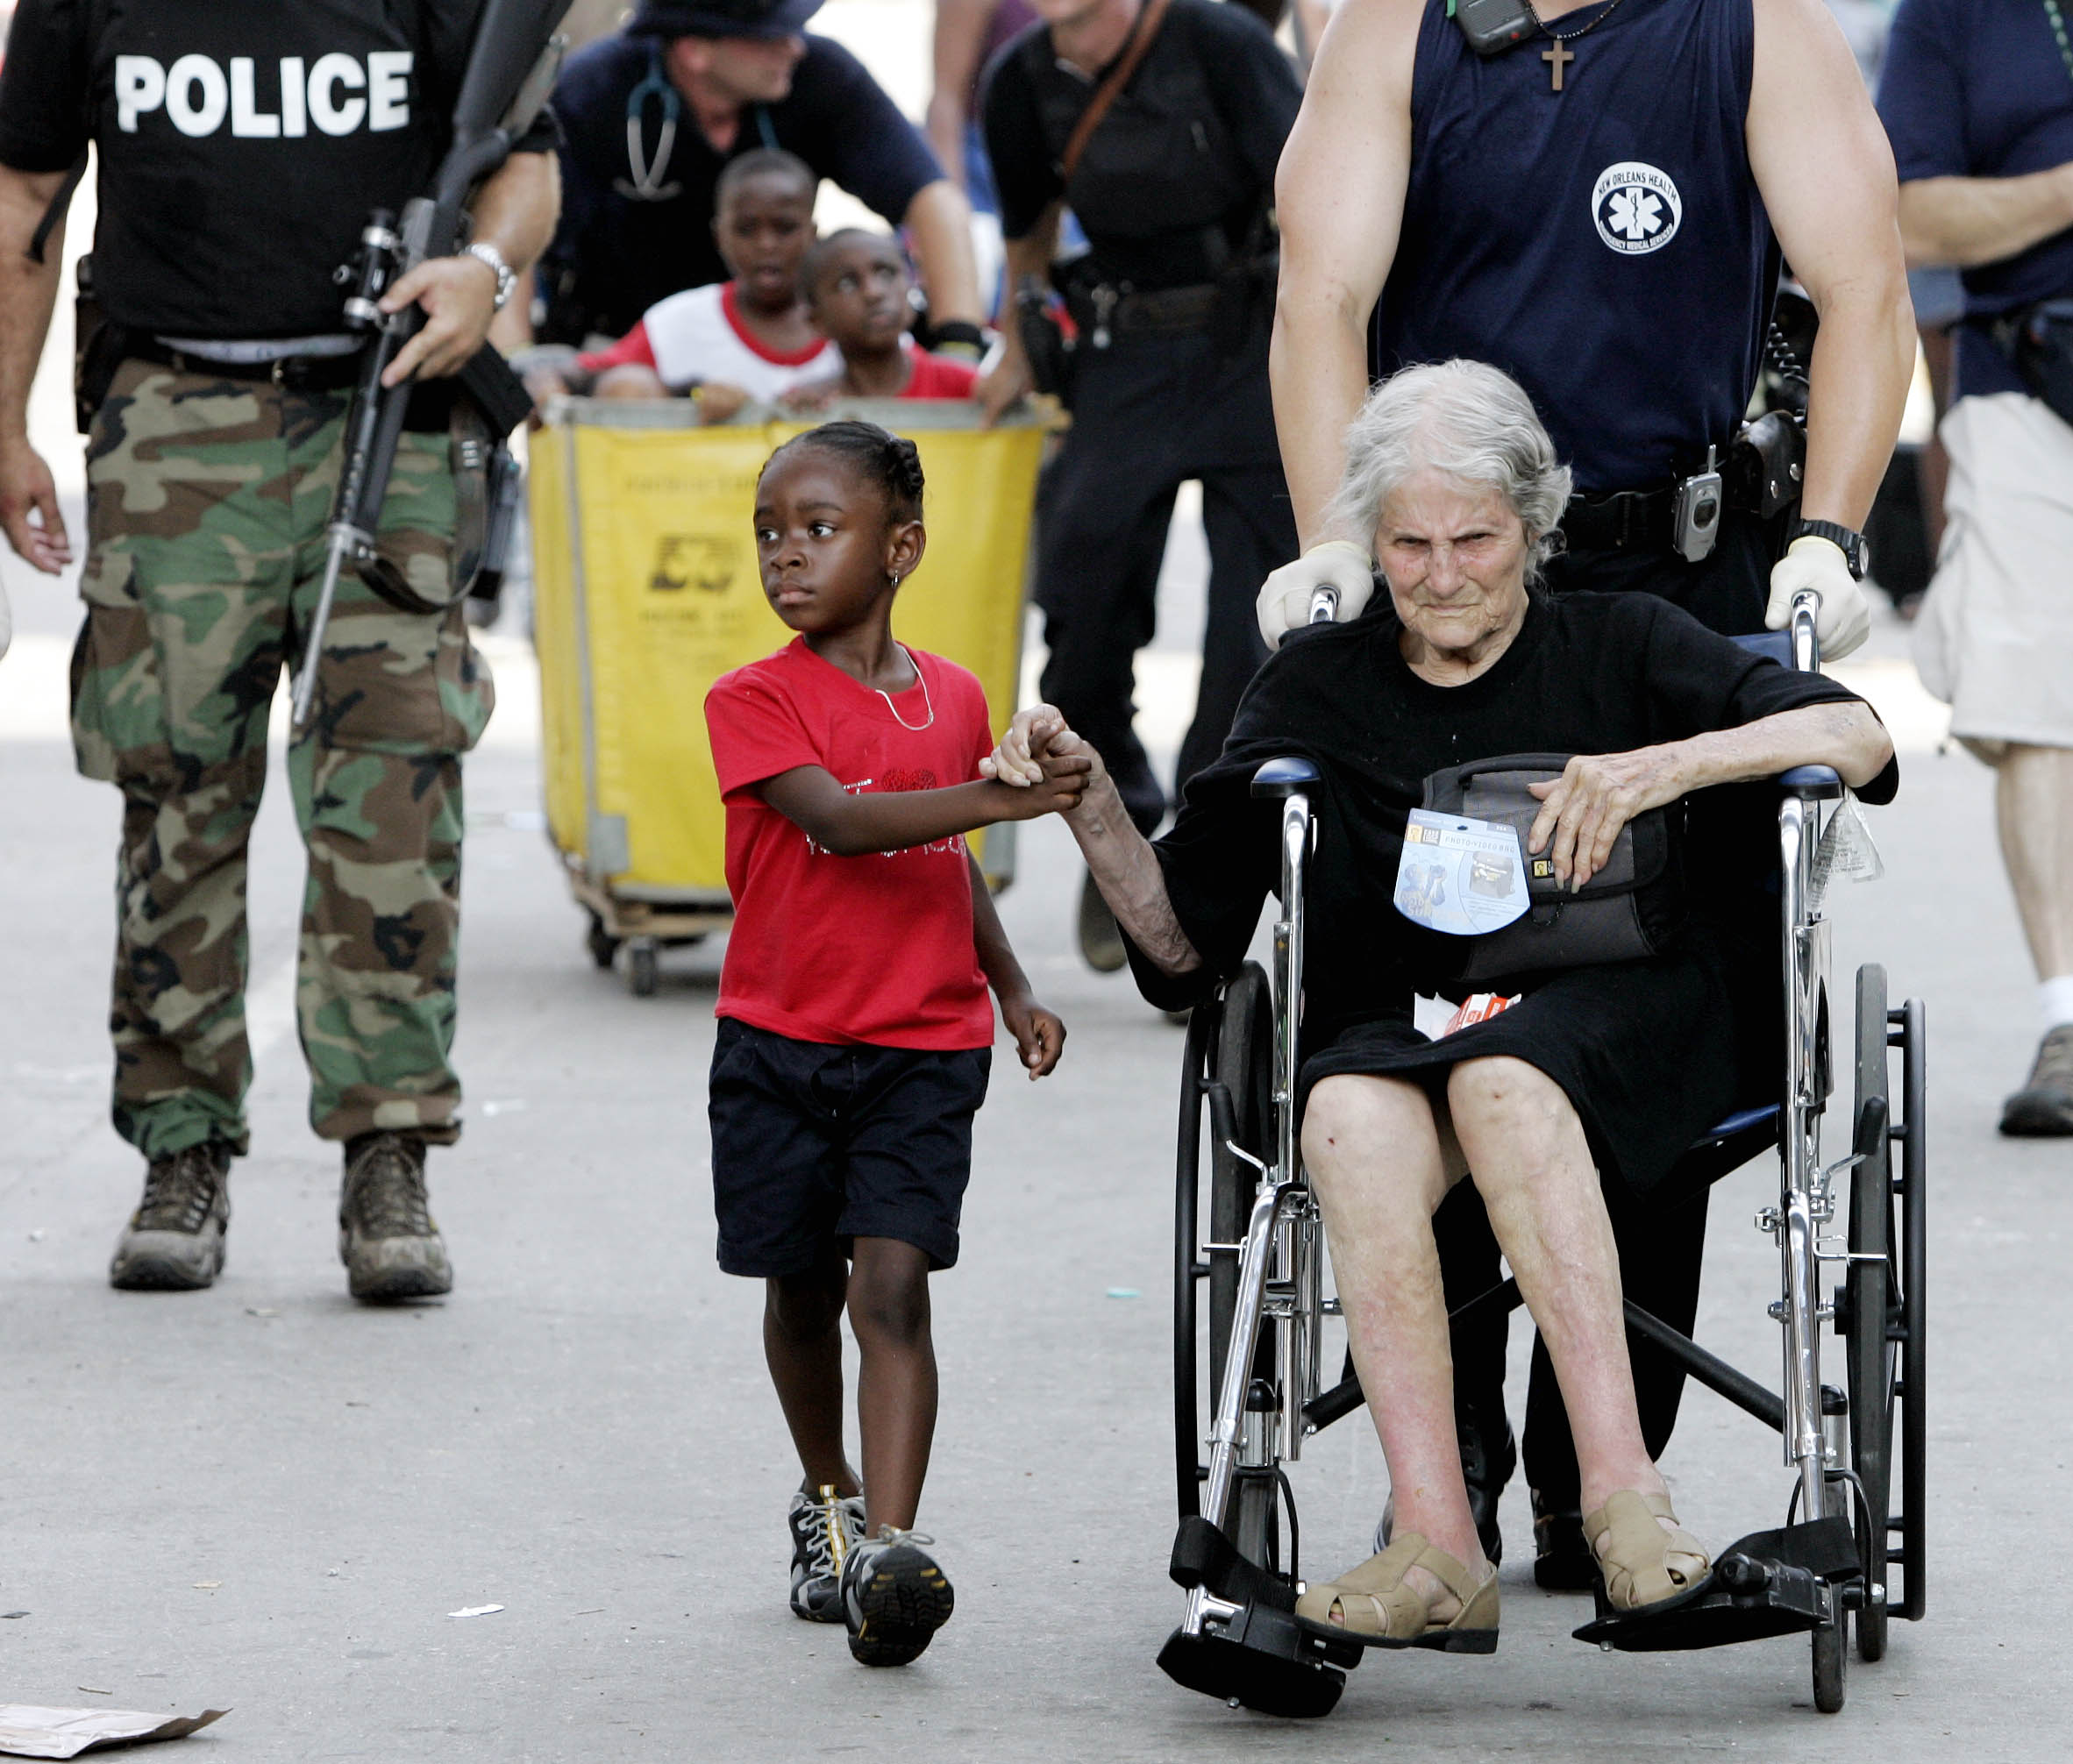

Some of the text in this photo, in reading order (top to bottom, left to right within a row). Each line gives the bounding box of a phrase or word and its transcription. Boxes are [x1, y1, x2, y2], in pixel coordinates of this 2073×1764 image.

[115, 51, 414, 138] POLICE
[1598, 172, 1677, 203] NEW ORLEANS HEALTH
